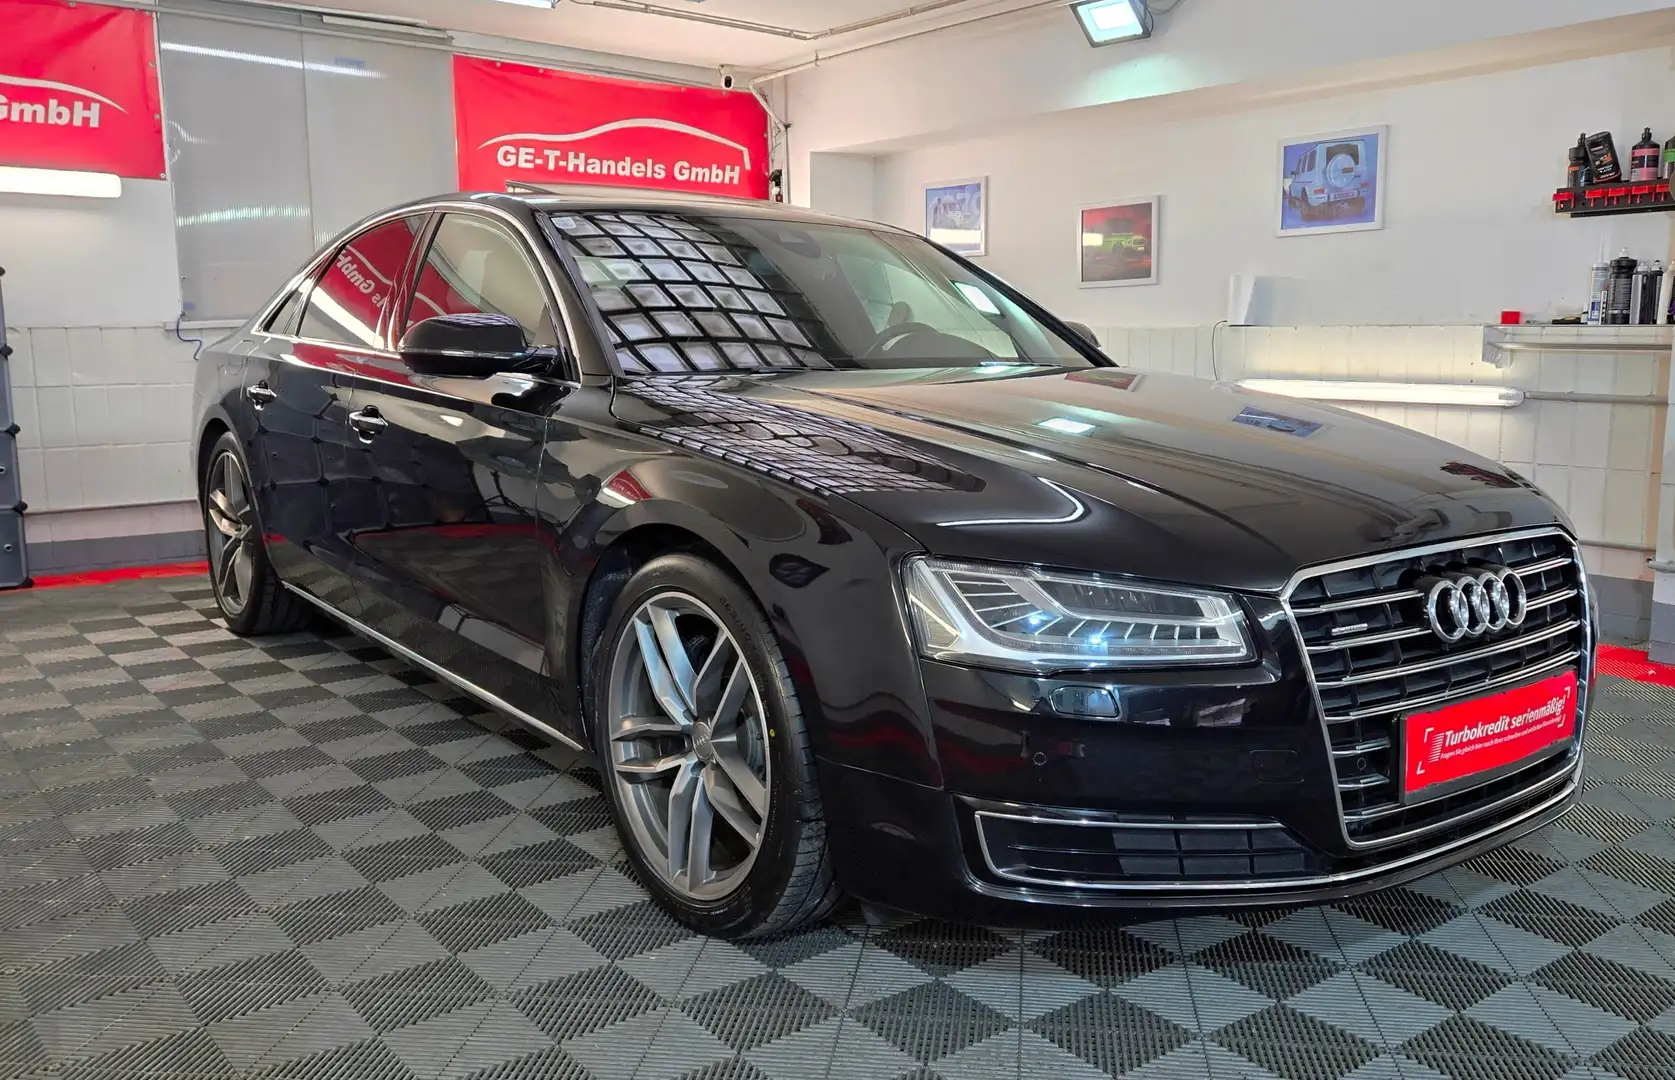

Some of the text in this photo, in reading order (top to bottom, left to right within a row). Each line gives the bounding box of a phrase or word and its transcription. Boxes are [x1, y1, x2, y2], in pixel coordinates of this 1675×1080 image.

[0, 94, 100, 128] mbH
[497, 145, 740, 184] GE-T-Handels GmbH
[1445, 694, 1567, 747] Turbokredit serienmäßig!
